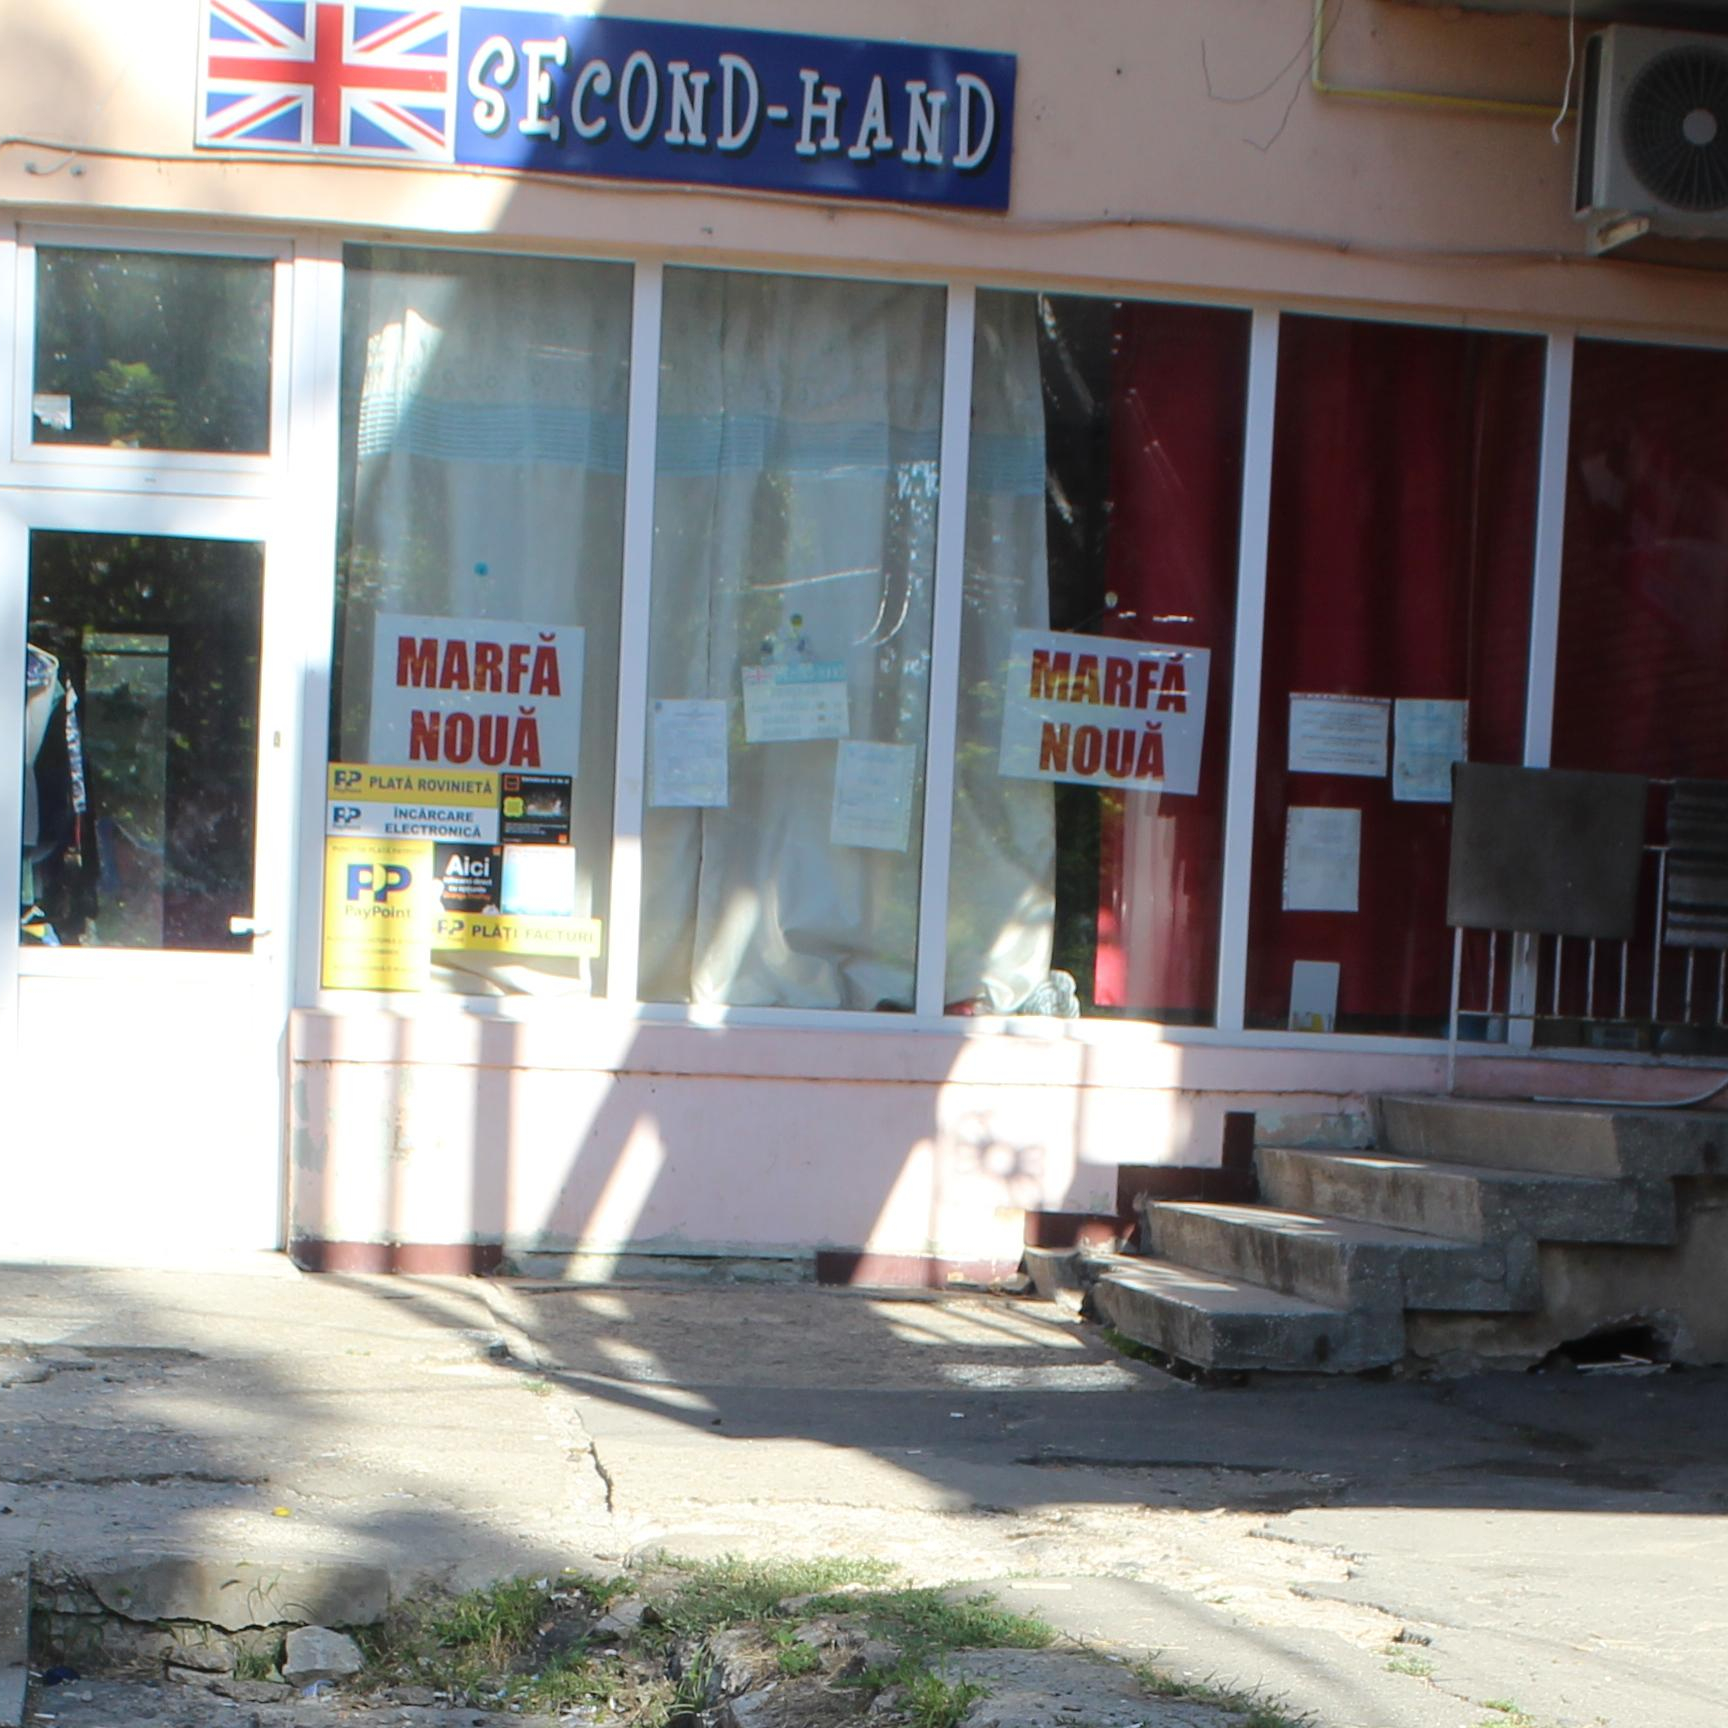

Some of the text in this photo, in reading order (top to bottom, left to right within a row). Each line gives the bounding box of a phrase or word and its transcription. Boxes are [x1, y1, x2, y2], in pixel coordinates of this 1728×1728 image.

[468, 34, 995, 169] SECOND-HAND
[396, 631, 561, 697] MARFĂ
[1030, 649, 1187, 714] MARFĂ
[409, 705, 541, 768] NOUĂ
[1039, 721, 1165, 781] NOUĂ
[445, 853, 491, 877] Aici
[344, 904, 411, 919] PayPoint
